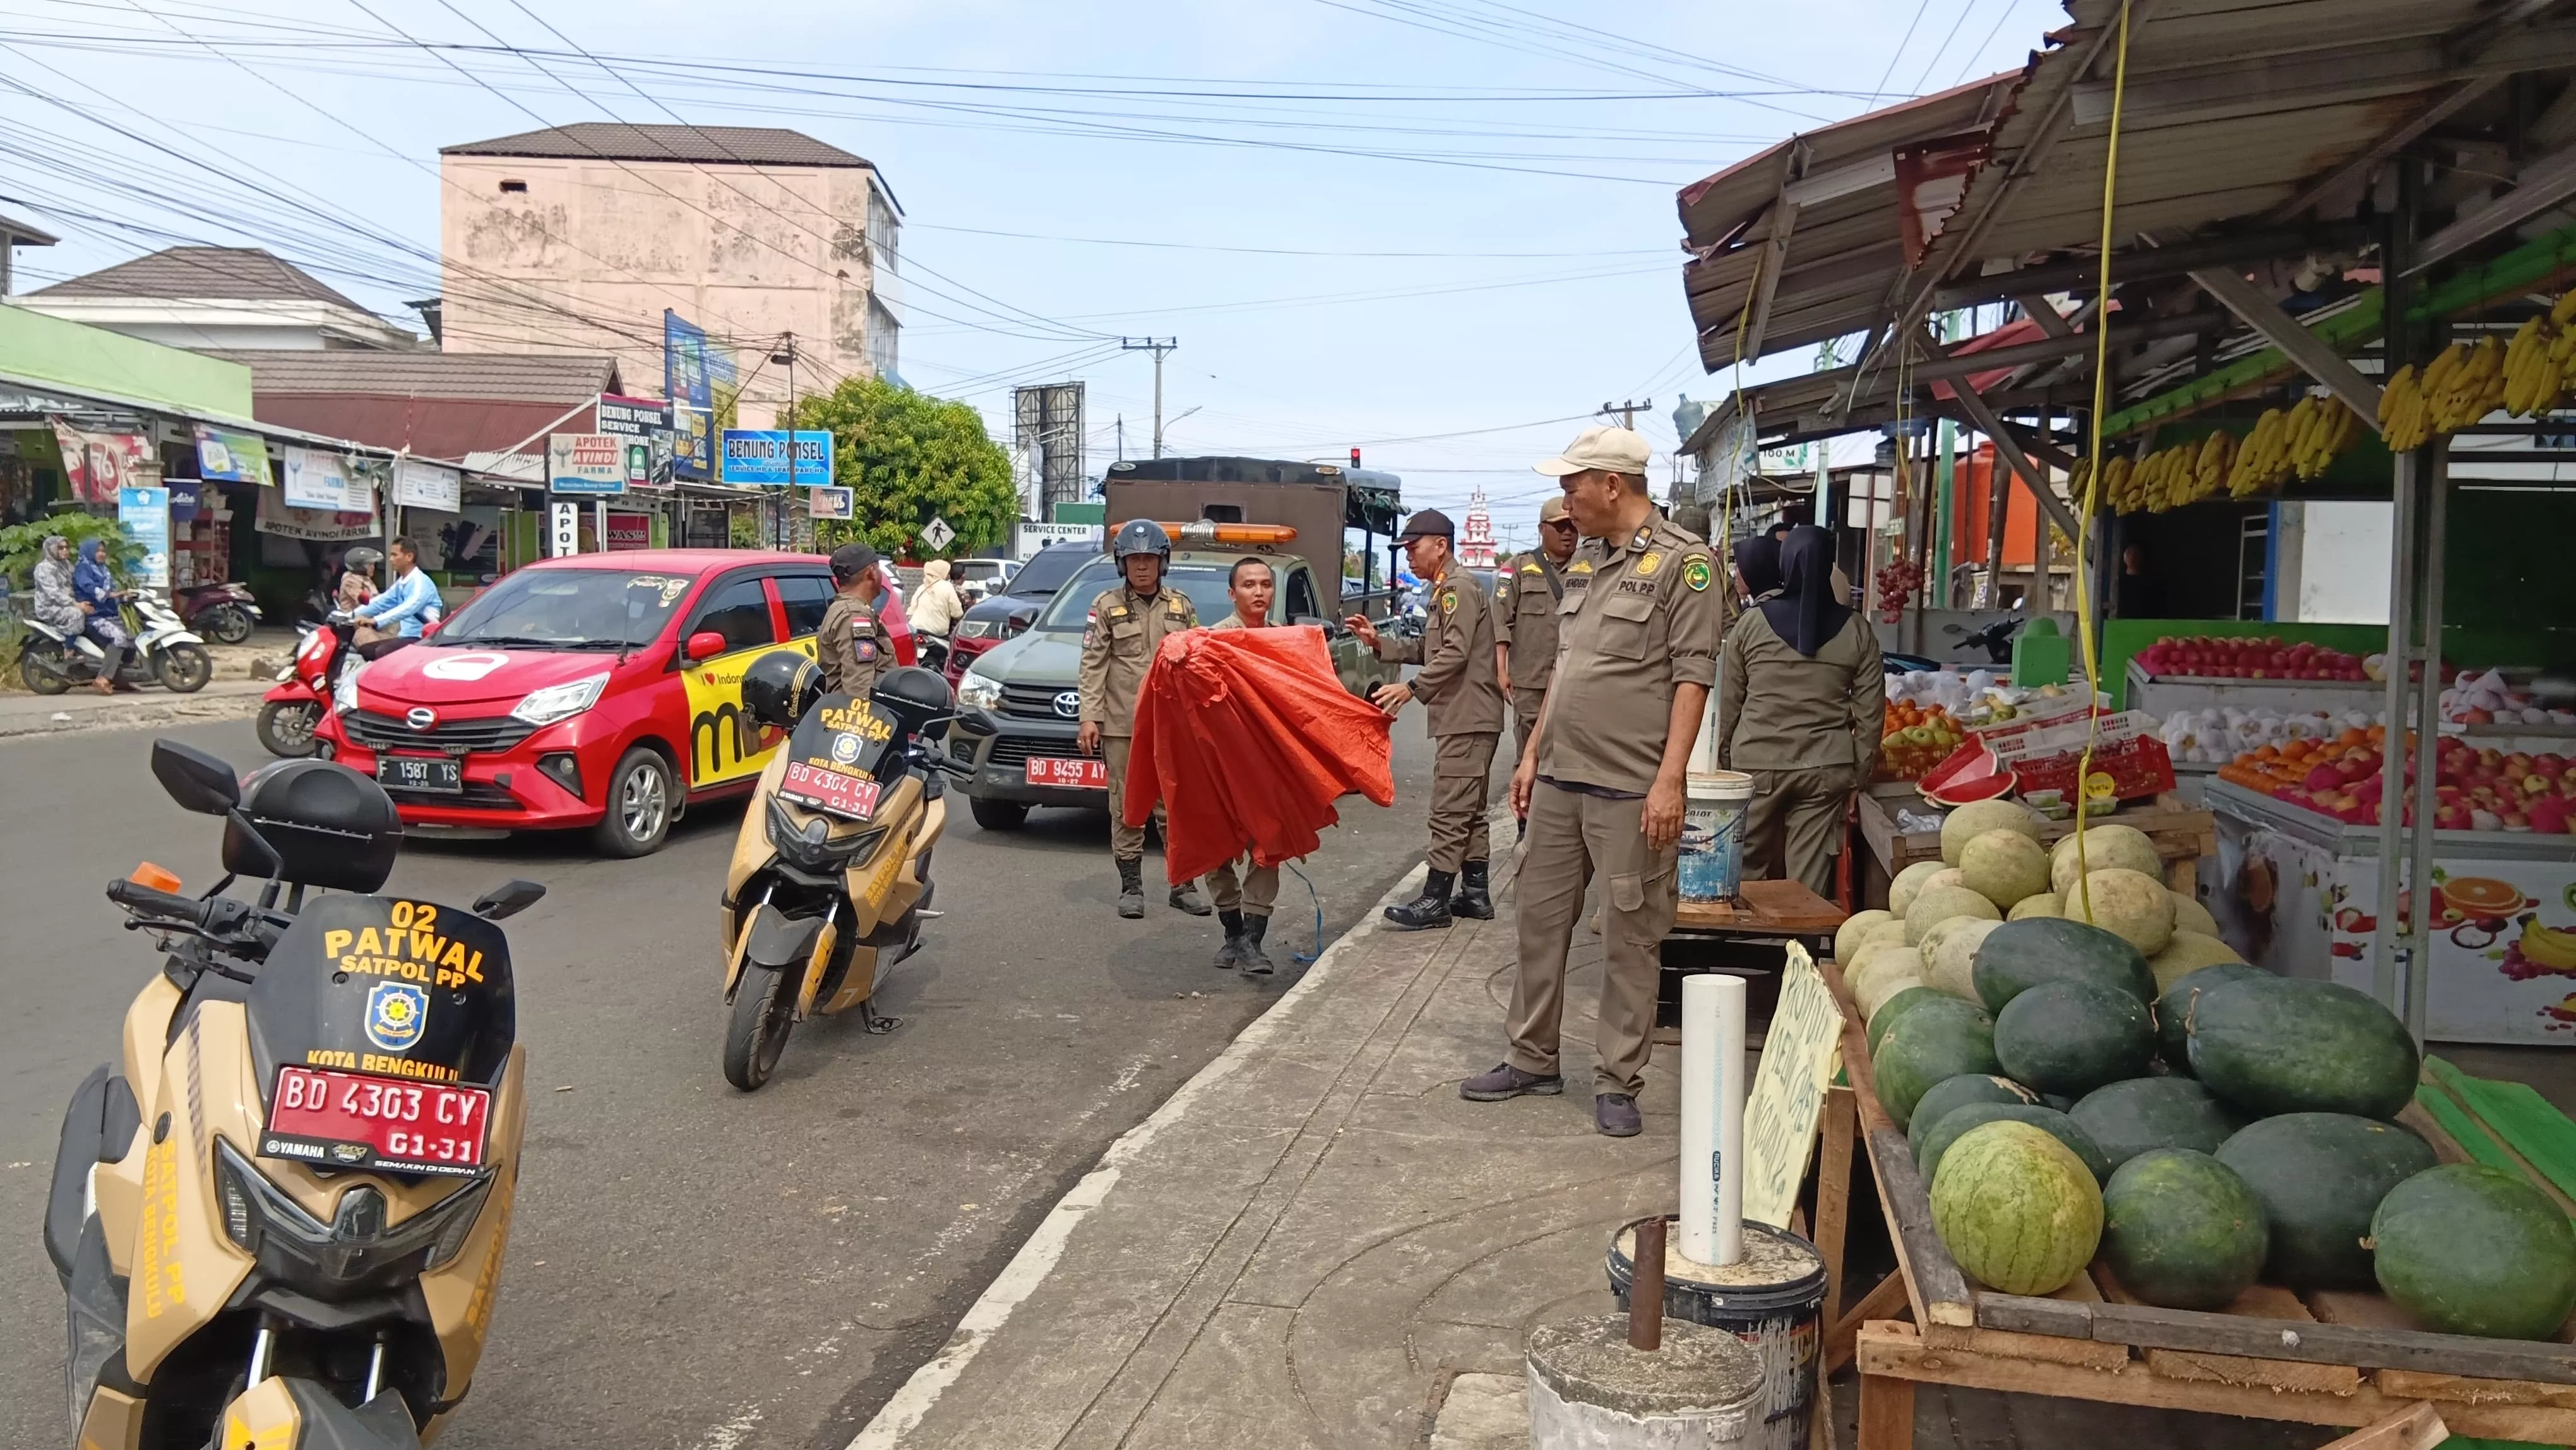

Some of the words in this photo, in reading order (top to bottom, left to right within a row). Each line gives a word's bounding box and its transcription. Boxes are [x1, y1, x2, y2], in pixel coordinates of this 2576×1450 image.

[602, 405, 631, 421] BENUNG
[634, 409, 662, 425] PONSEL
[601, 421, 640, 433] SERVICE
[576, 436, 617, 448] APOTEK
[729, 440, 775, 459] BENUNG
[573, 450, 619, 464] AVINDI
[577, 466, 612, 474] FARMA
[342, 525, 372, 537] FARMA
[1023, 525, 1056, 534] SERVICE
[1058, 526, 1087, 535] CENTER
[1619, 580, 1638, 593] POL
[1639, 584, 1655, 595] PP
[850, 698, 871, 714] 01
[821, 709, 891, 740] PATWAL
[826, 720, 865, 736] SATPOL
[867, 730, 883, 740] PP
[379, 760, 388, 777] F
[400, 762, 428, 779] 1587
[441, 764, 457, 781] YS
[809, 757, 829, 769] KOTA
[1030, 760, 1047, 776] BD
[1053, 761, 1083, 778] 9455
[1091, 763, 1106, 779] AY
[790, 765, 810, 782] BD
[854, 782, 874, 800] CY
[391, 901, 437, 933] 02
[325, 927, 484, 983] PATWAL
[339, 955, 431, 983] SATPOL
[436, 968, 466, 988] PP
[307, 1050, 357, 1069] KOTA
[361, 1053, 460, 1082] BENGKULU
[285, 1076, 328, 1110] BD
[342, 1082, 424, 1122] 4303
[438, 1093, 477, 1127] CY
[280, 1141, 325, 1158] YAMAHA
[145, 1146, 158, 1201] KOTA
[374, 1159, 424, 1170] SEMAKIN
[438, 1166, 476, 1175] DEPAN
[161, 1139, 179, 1257] SATPOL
[143, 1202, 163, 1319] BENGKULU
[165, 1261, 186, 1305] PP
